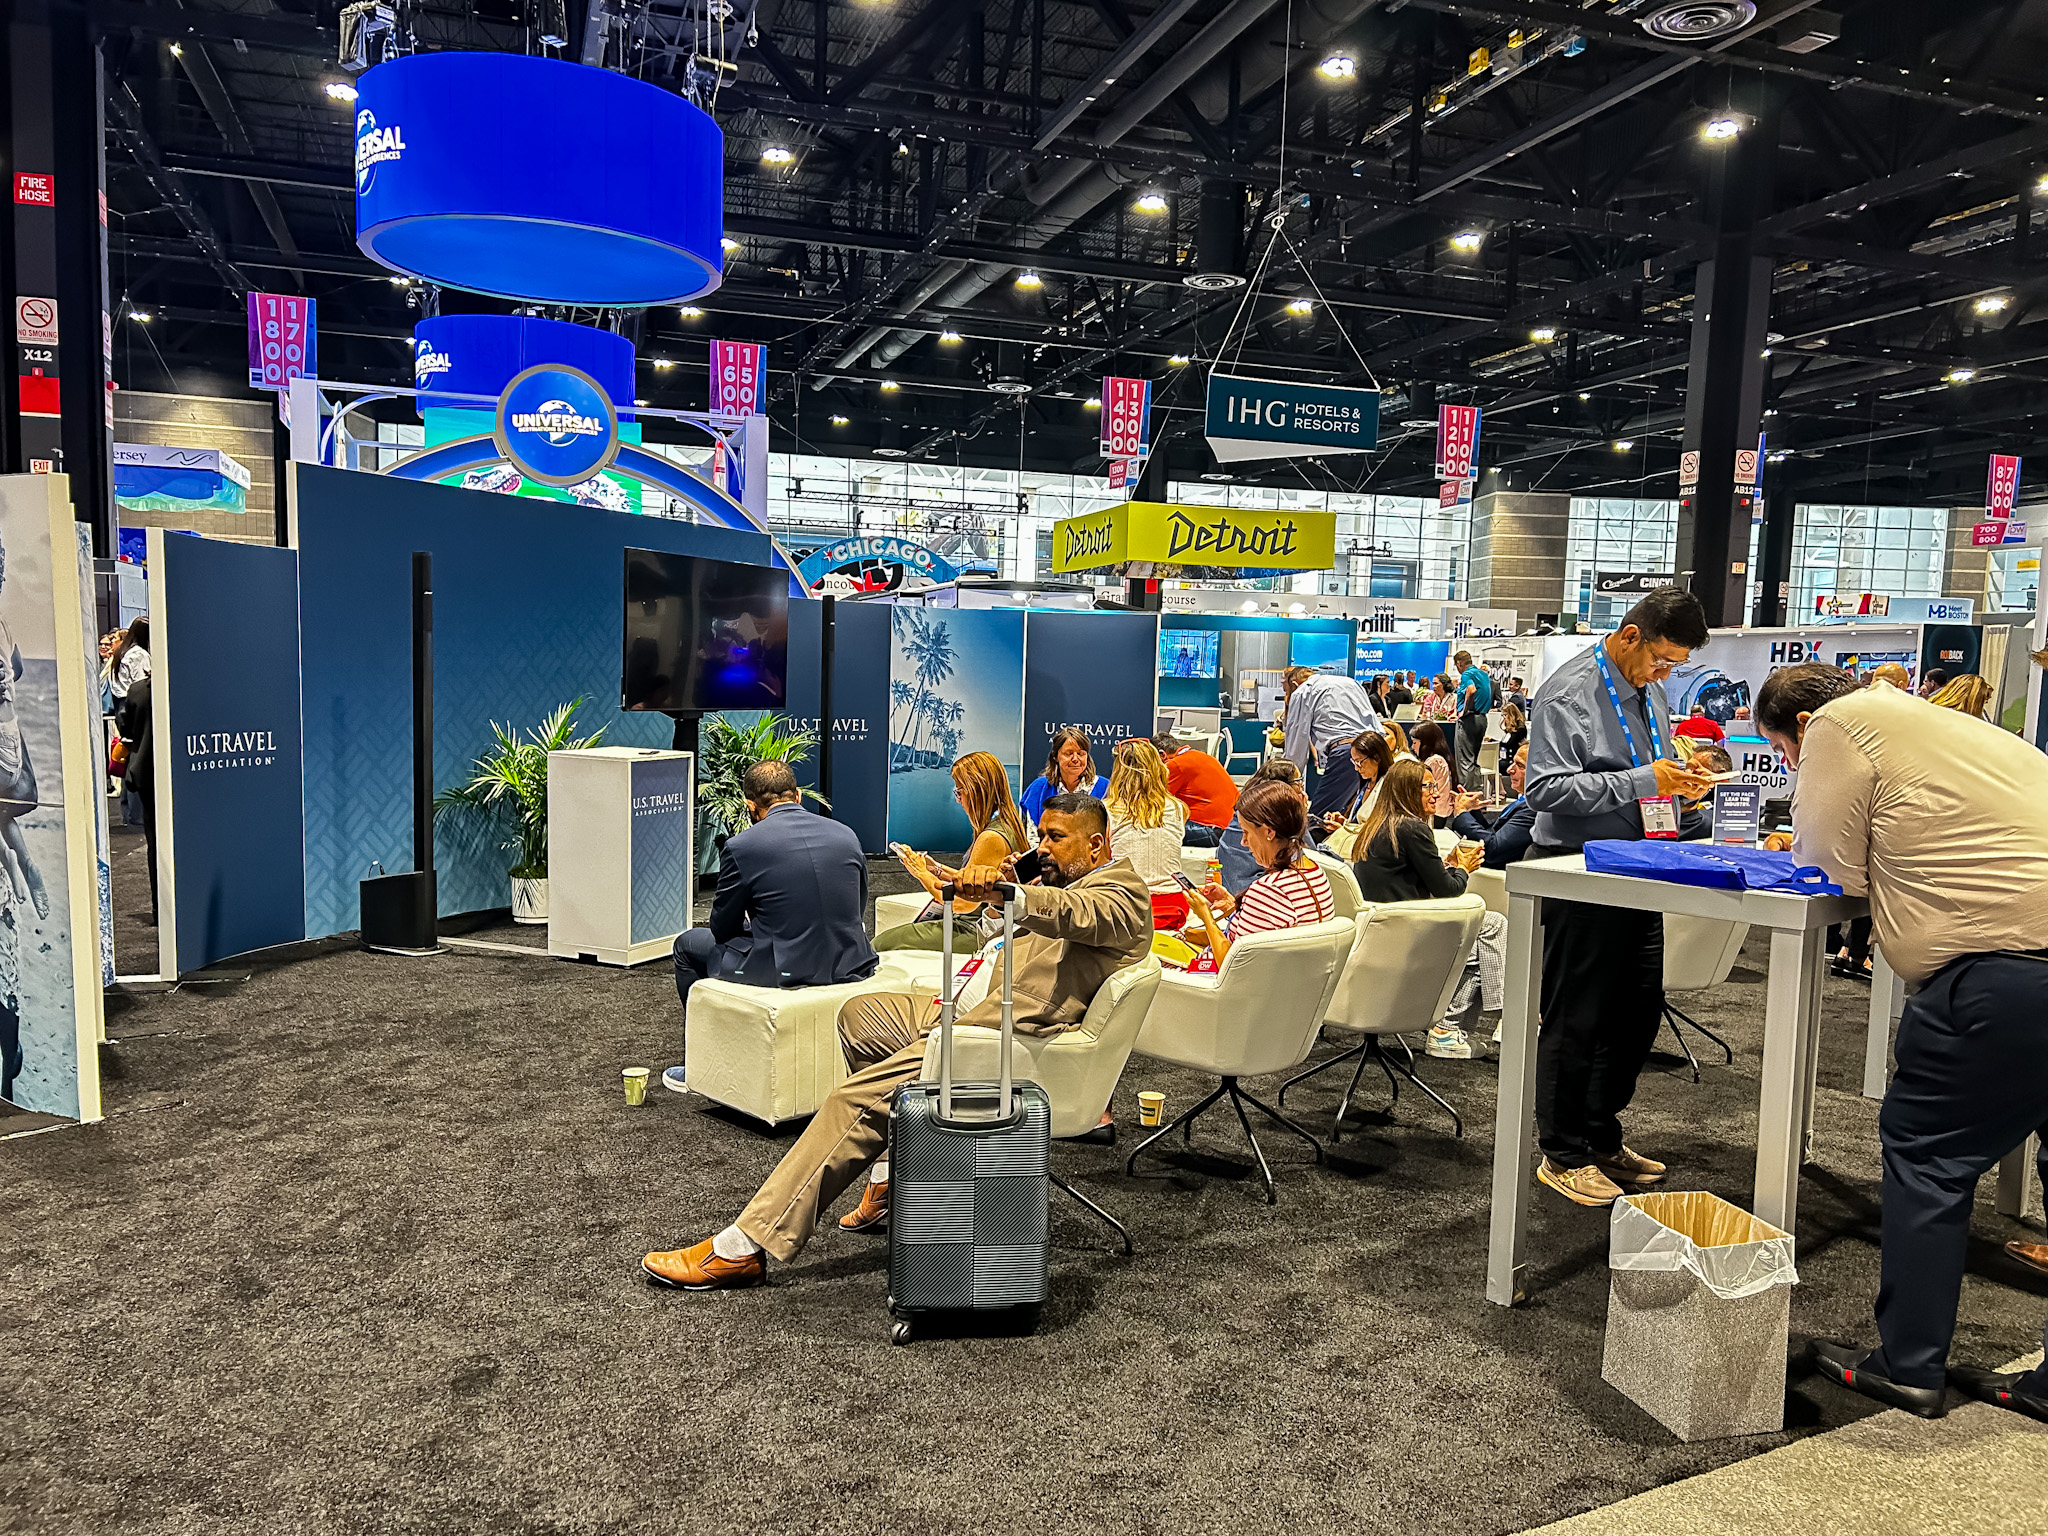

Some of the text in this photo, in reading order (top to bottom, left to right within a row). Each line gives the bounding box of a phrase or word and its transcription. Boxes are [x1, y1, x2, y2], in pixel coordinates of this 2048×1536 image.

[358, 126, 406, 162] ERSAL
[21, 176, 47, 189] FIRE
[19, 189, 50, 202] HOSE
[18, 329, 58, 338] NO SMOKING
[24, 349, 52, 361] X12
[1227, 396, 1361, 427] IHG HOTELS &
[512, 414, 603, 431] UNIVERSAL
[1294, 417, 1360, 434] RESORTS
[33, 461, 49, 471] EXIT
[1680, 486, 1697, 496] AB12
[1734, 486, 1754, 495] AB12
[1166, 510, 1298, 559] Detroit
[2007, 525, 2024, 535] ipw
[1064, 516, 1113, 567] Detroit
[833, 538, 931, 567] CHICAGO
[1640, 577, 1673, 588] CINCY
[1770, 641, 1823, 663] HBX
[787, 718, 868, 732] U.S. TAVEL
[1045, 722, 1067, 734] U.S
[186, 731, 277, 756] U.S. TRAVEL
[191, 757, 272, 771] ASSOCIATION
[1743, 752, 1787, 775] HBX
[1742, 774, 1787, 788] GROUP
[633, 792, 685, 809] U.S. TRAVEL
[635, 806, 682, 816] ASSOCIATION
